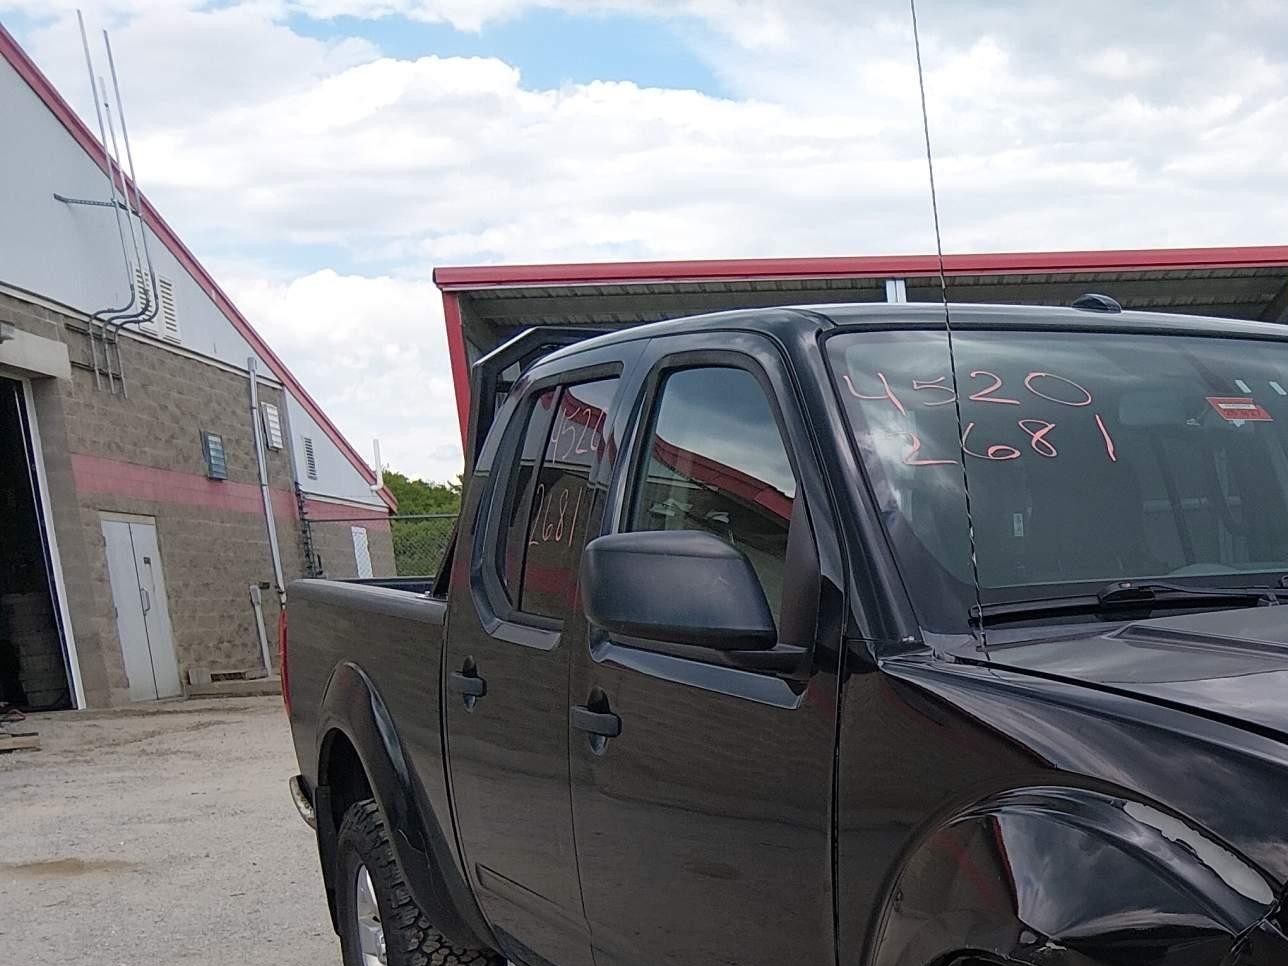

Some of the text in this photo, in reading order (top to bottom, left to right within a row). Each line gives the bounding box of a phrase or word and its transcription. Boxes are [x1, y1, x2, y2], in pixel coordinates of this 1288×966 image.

[844, 371, 1092, 417] 4520
[887, 414, 1116, 466] 2681
[528, 483, 583, 547] 2681
